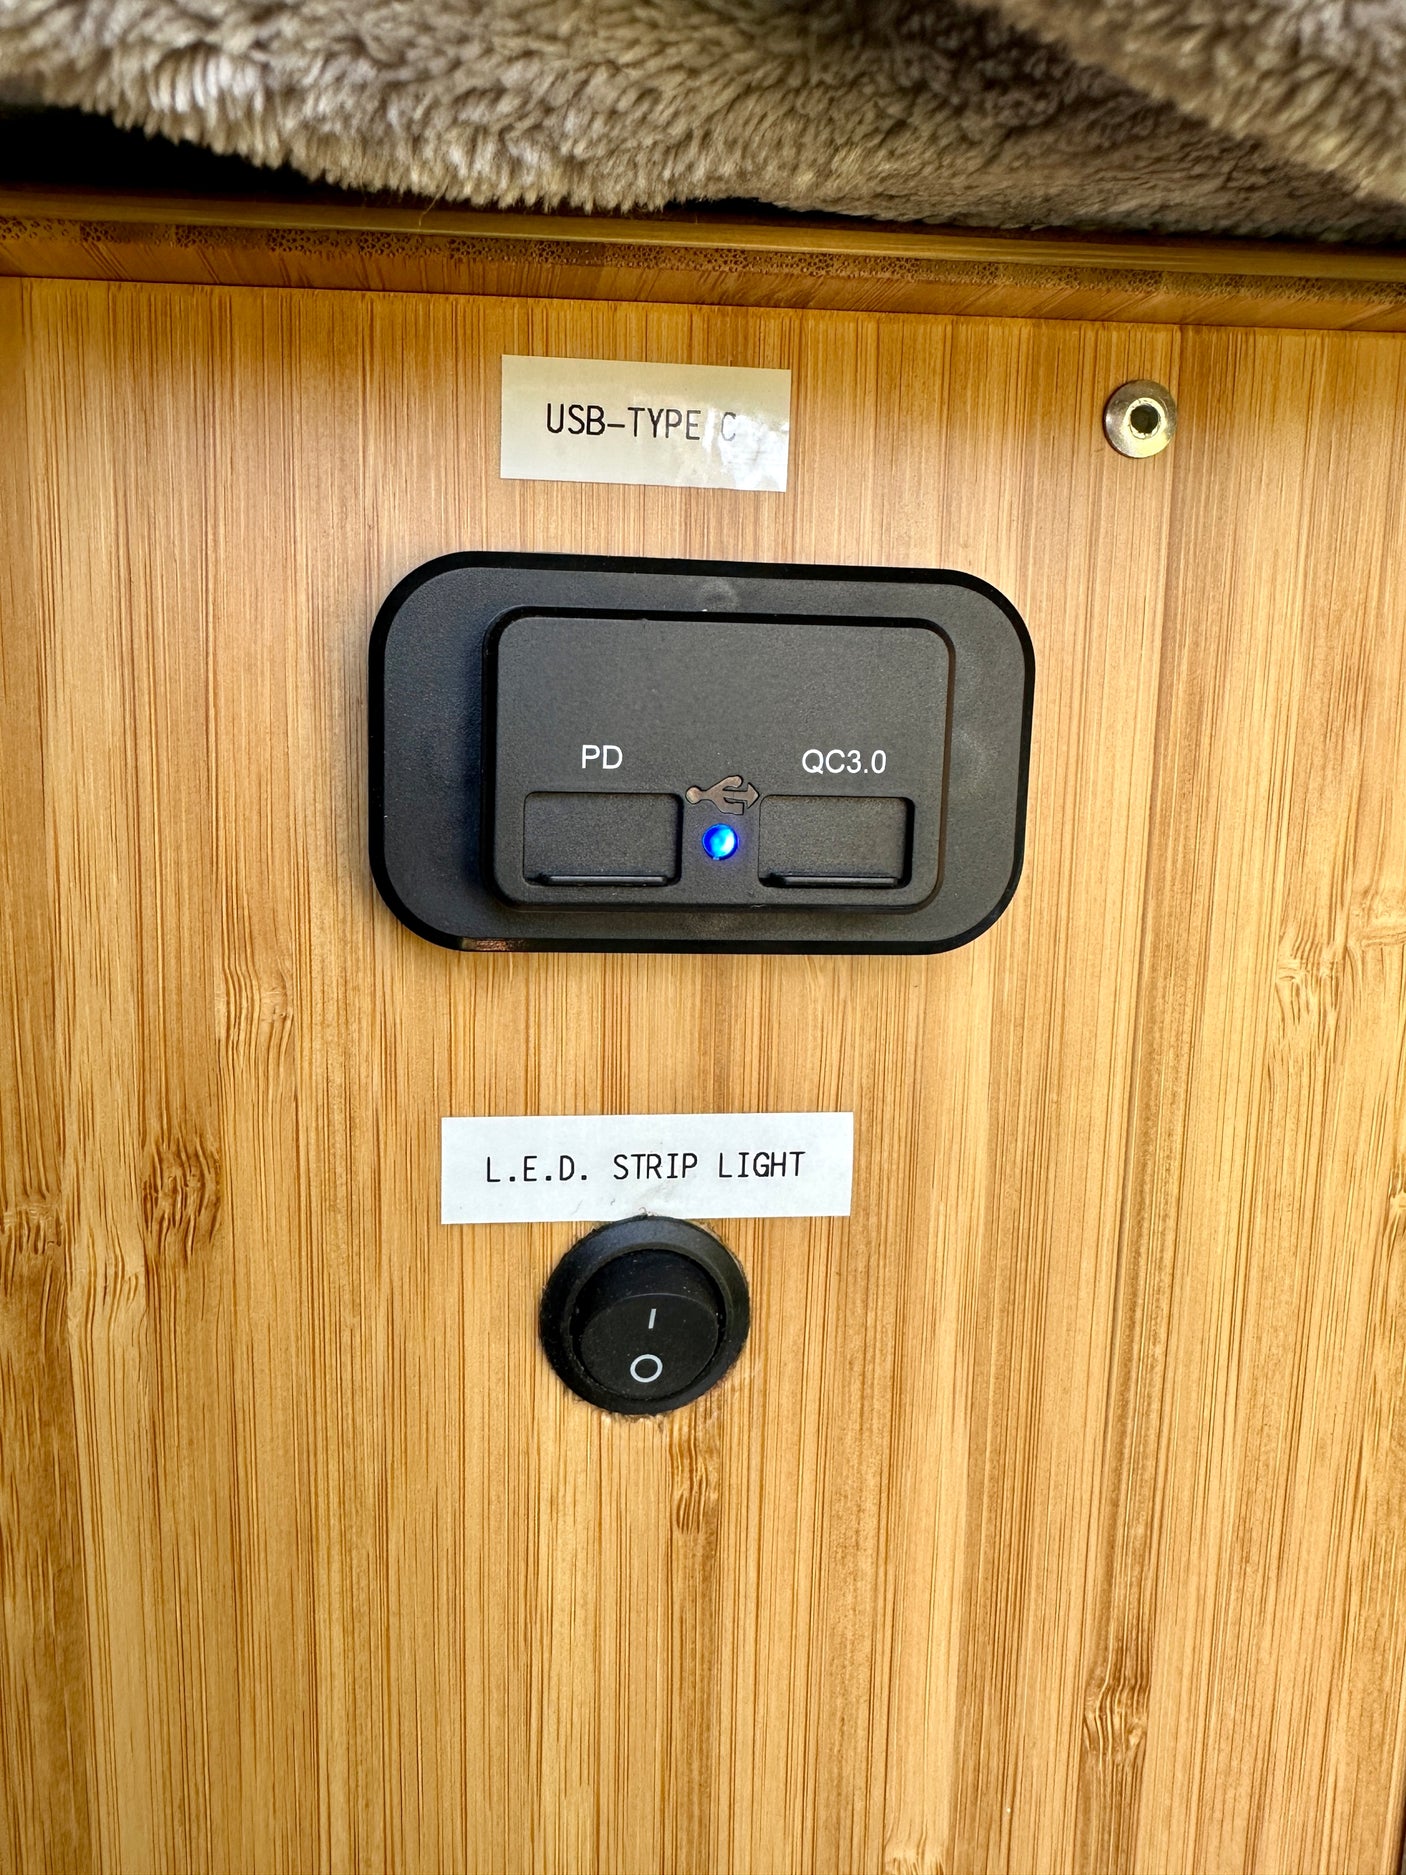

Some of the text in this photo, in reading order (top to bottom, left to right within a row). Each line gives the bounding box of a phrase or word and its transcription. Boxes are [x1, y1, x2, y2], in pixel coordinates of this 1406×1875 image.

[546, 402, 737, 442] USB-TYPE C
[581, 744, 624, 770] PD
[801, 749, 888, 775] QC3.0
[486, 1150, 806, 1183] L.E.D. STRIP LIGHT
